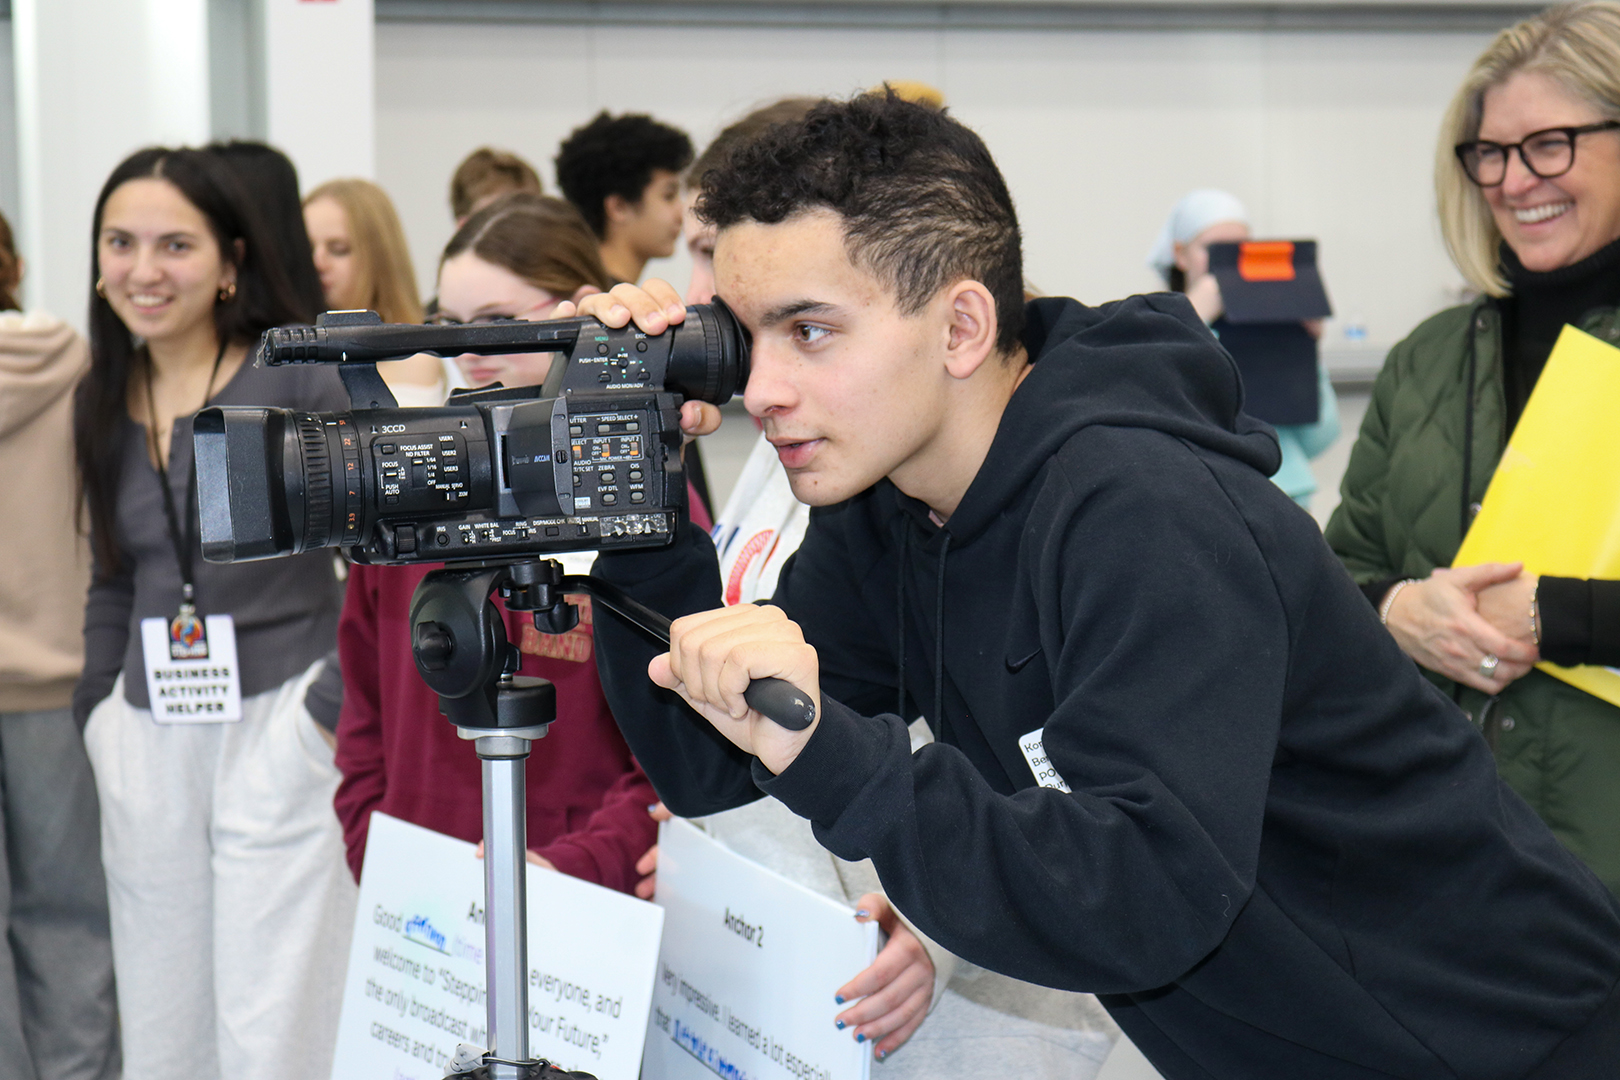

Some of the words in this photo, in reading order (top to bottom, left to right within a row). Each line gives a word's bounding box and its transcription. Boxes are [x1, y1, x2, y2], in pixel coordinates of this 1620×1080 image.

[381, 424, 406, 434] 3CCD
[154, 668, 229, 679] BUSINESS
[159, 685, 228, 696] ACTIVITY
[166, 702, 224, 713] HELPER
[1039, 768, 1056, 781] PO
[373, 904, 404, 933] Good
[722, 907, 756, 944] Anchor
[756, 925, 764, 949] 2
[373, 946, 420, 979] welcome
[422, 965, 436, 985] to
[439, 967, 487, 1006] “Steppin
[529, 969, 591, 1013] everyone,
[595, 994, 623, 1019] and
[365, 977, 383, 1002] the
[385, 990, 408, 1018] only
[410, 993, 468, 1040] broadcast
[470, 1025, 487, 1047] wh
[370, 1021, 410, 1053] careers
[411, 1040, 436, 1064] and
[727, 1006, 761, 1050] learned
[762, 1036, 768, 1055] a
[769, 1035, 784, 1066] lot
